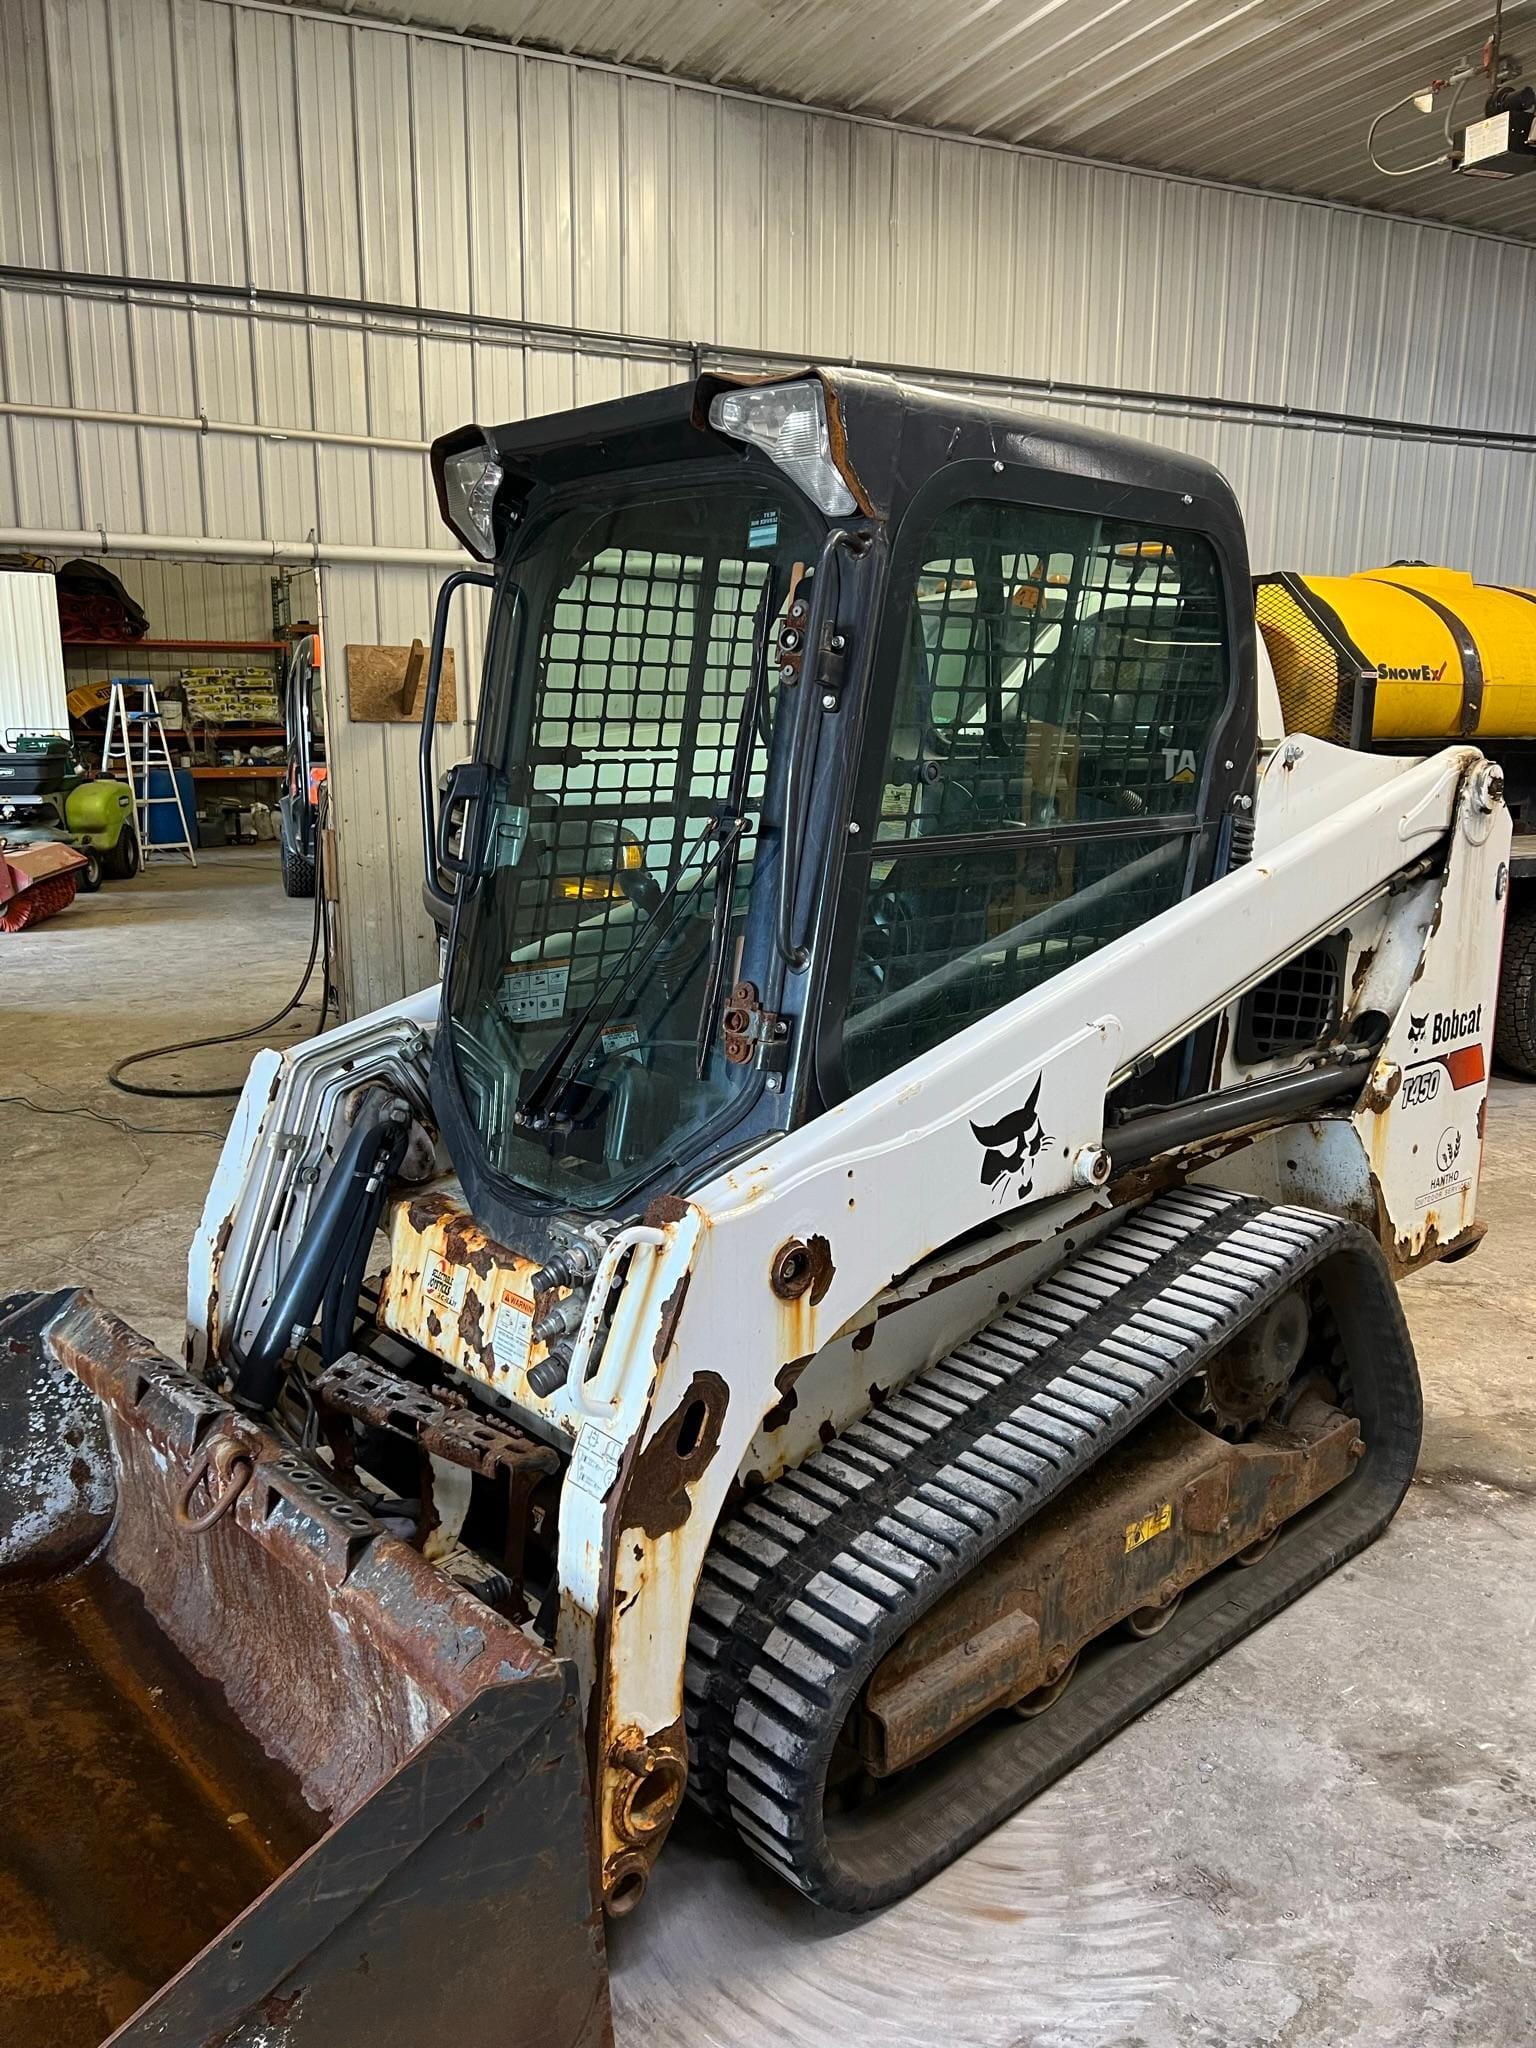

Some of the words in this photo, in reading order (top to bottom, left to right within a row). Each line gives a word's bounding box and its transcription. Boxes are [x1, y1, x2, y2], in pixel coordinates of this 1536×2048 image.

[1432, 1003, 1482, 1045] Bobcat
[1402, 1069, 1441, 1110] T450
[1430, 1170, 1459, 1190] HANTHO
